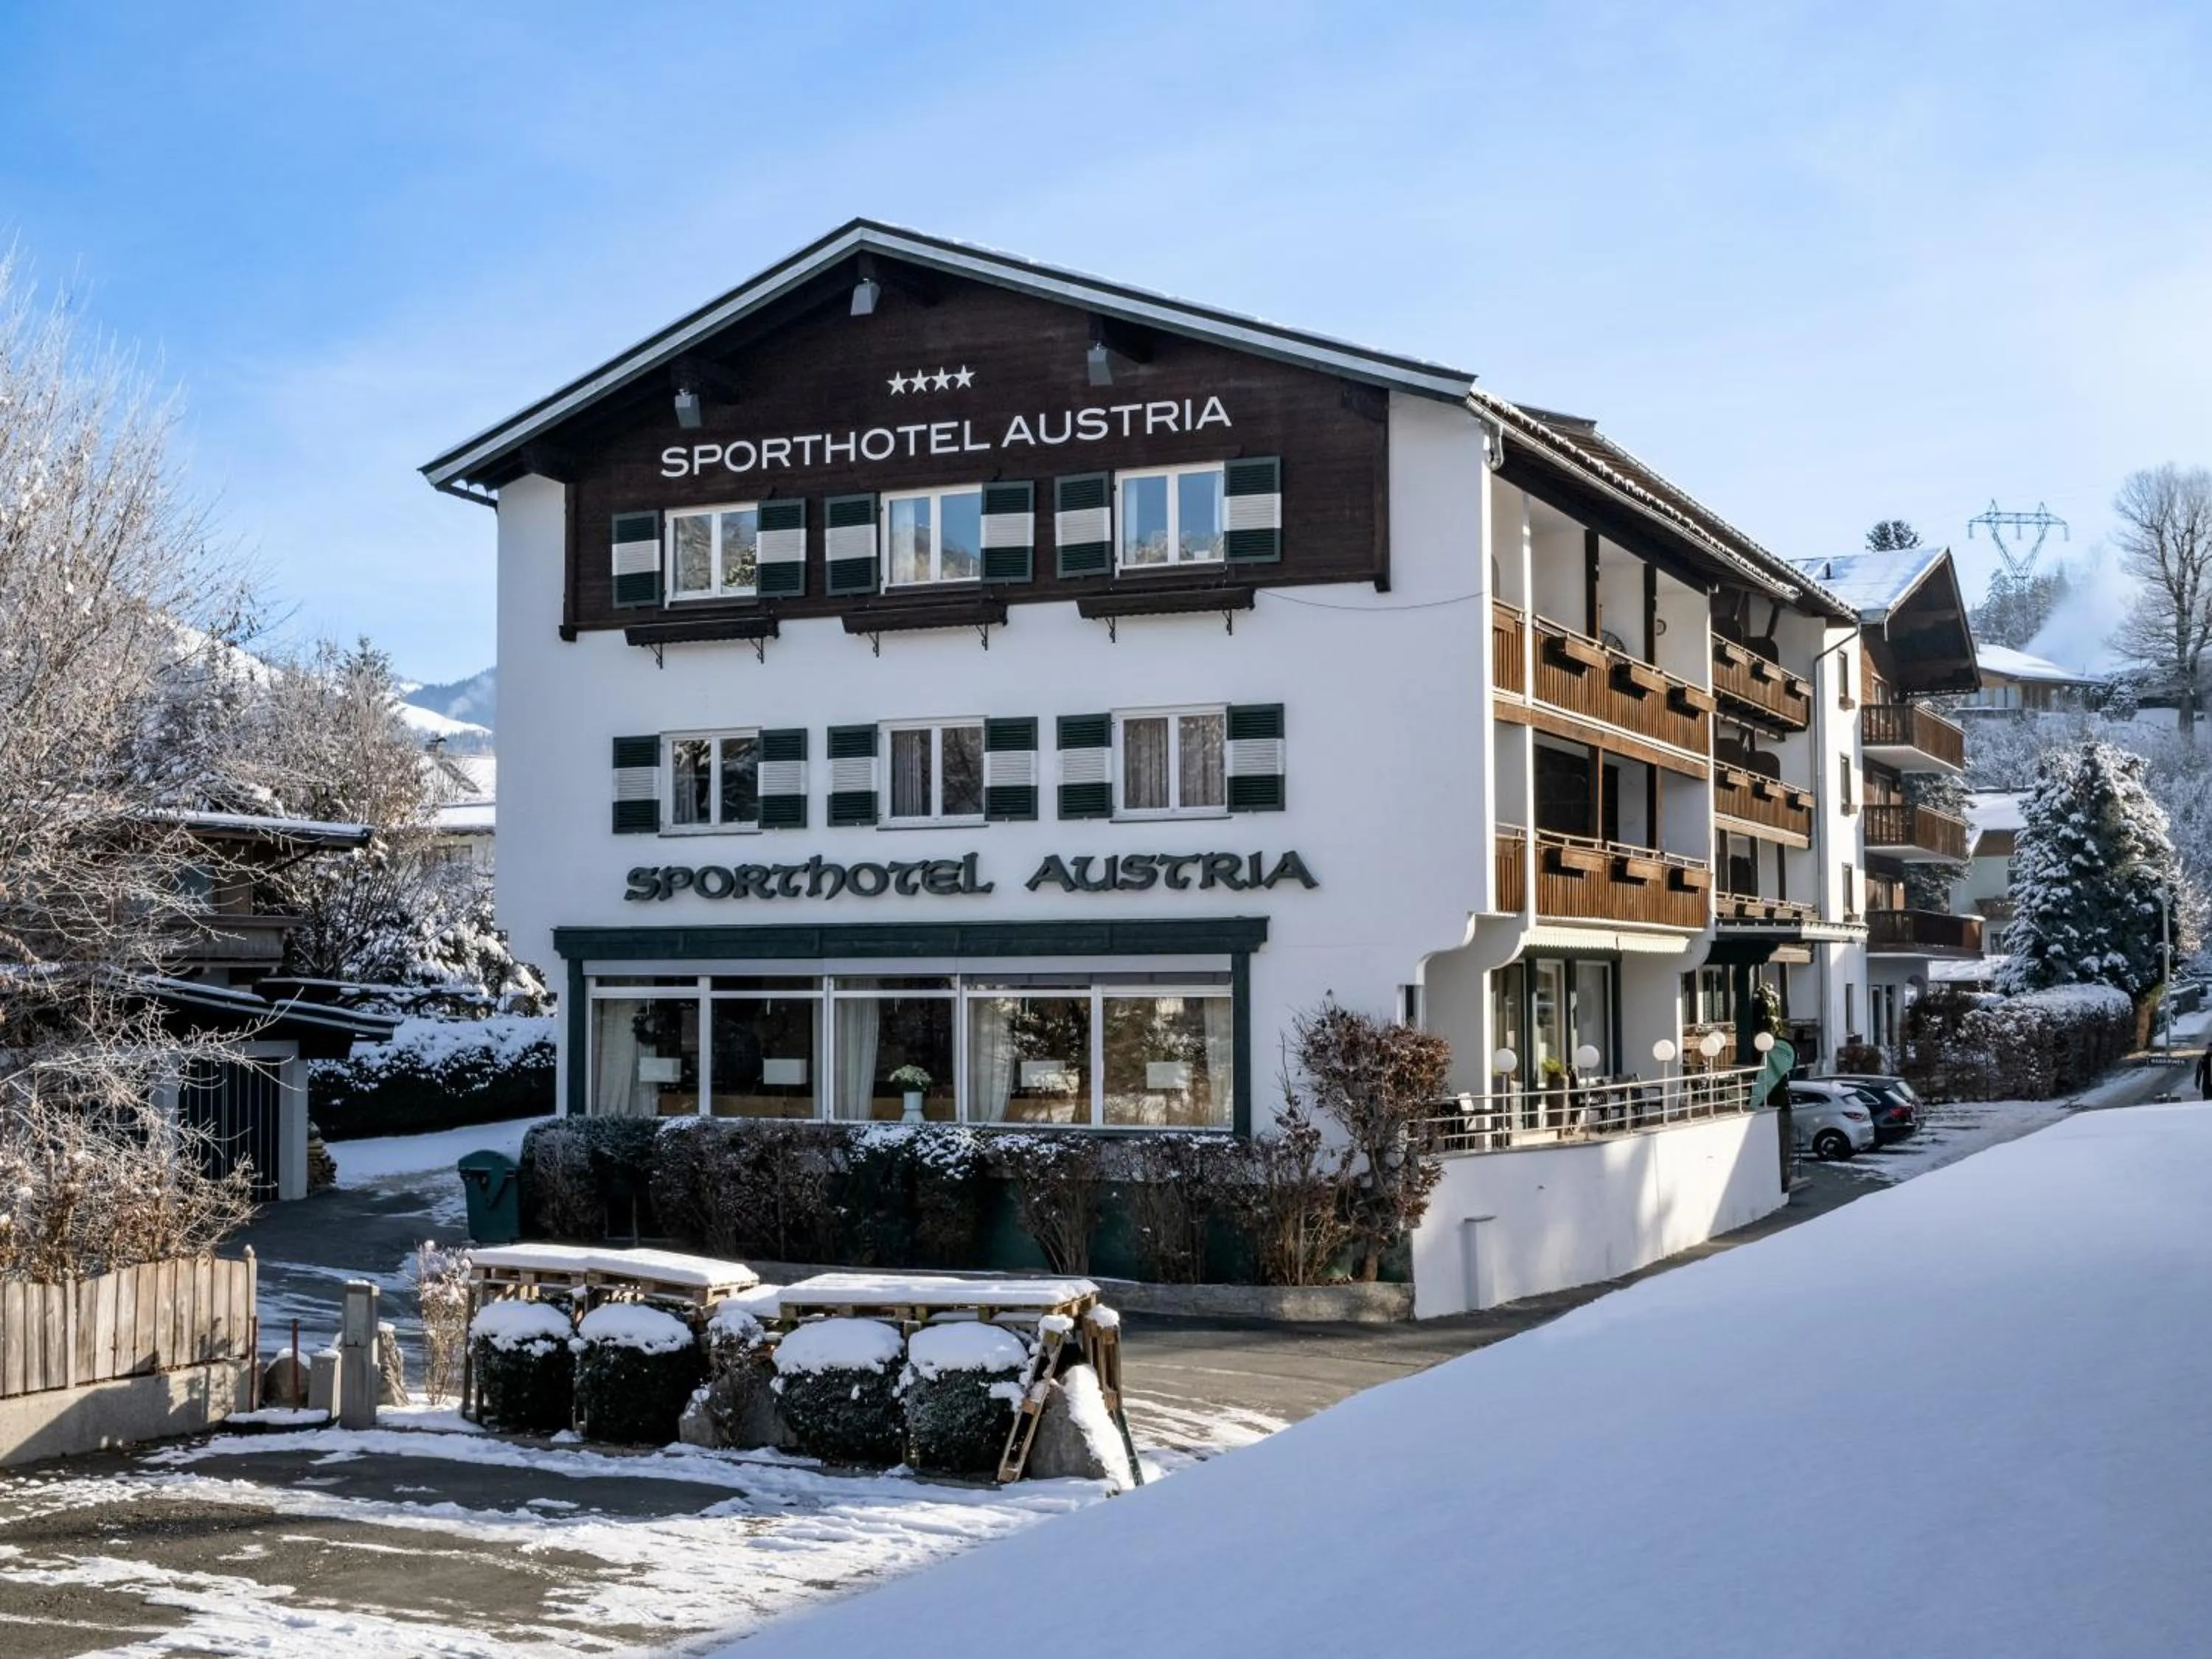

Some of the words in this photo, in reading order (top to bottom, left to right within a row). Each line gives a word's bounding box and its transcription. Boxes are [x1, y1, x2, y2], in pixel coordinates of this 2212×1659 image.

[660, 420, 992, 478] SPORTHOTEL
[1001, 396, 1233, 448] AUSTRIA
[1024, 850, 1321, 894] AUSTRIA
